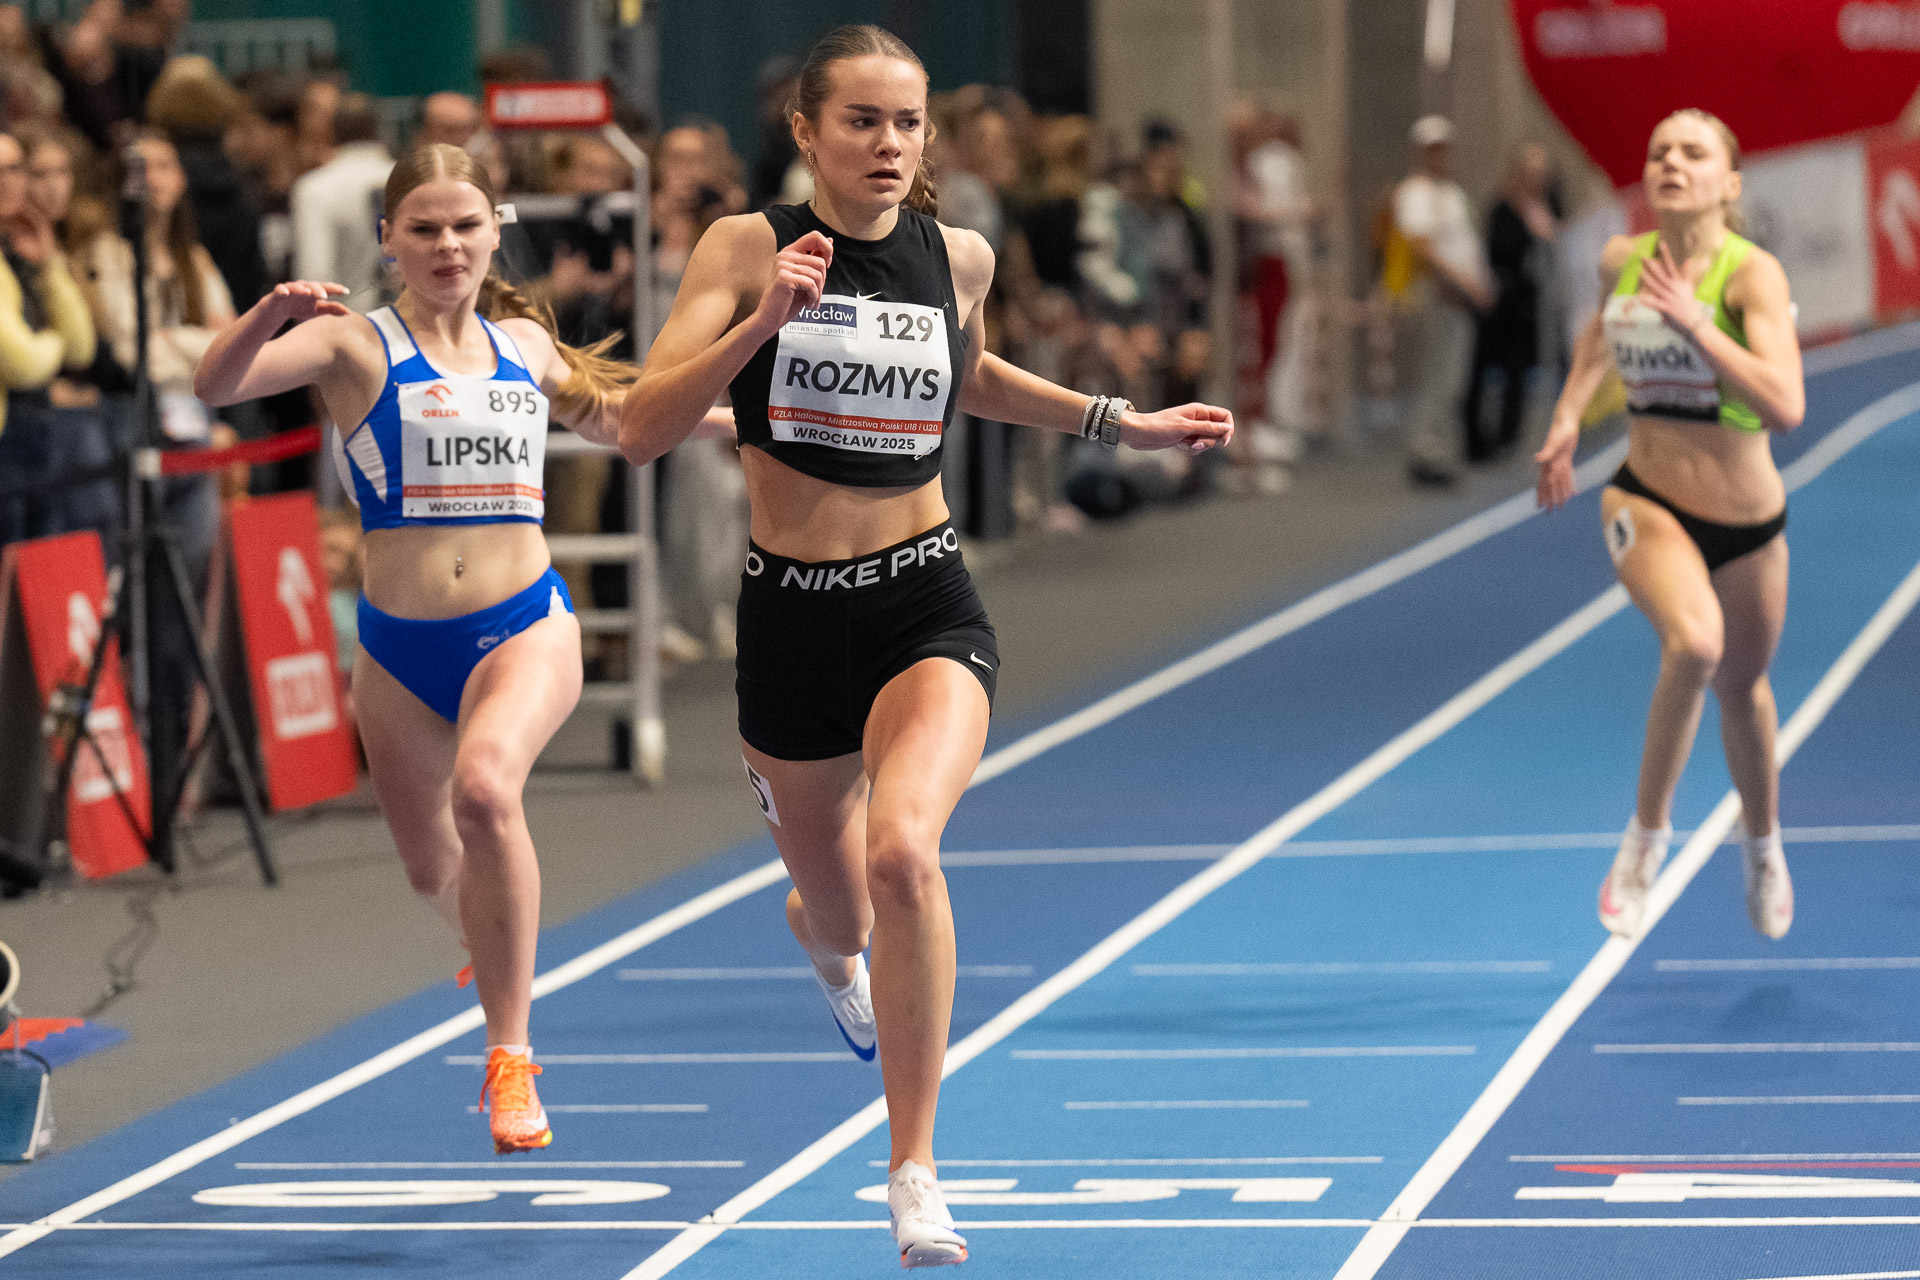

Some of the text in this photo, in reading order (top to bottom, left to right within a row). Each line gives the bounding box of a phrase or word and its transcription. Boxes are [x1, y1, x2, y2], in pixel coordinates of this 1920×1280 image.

[789, 324, 855, 336] miasto spotkań
[876, 312, 933, 342] 129
[785, 357, 940, 402] ROZMYS
[422, 409, 460, 418] ORLEN
[488, 390, 537, 415] 895
[773, 410, 792, 418] PZLA
[794, 411, 826, 422] Halowe
[828, 416, 878, 428] Mistrzostwa
[880, 422, 902, 430] Polski
[903, 423, 917, 431] U18
[922, 424, 938, 432] U20
[793, 426, 916, 450] WROCŁAW 2025
[426, 436, 530, 467] LIPSKA
[428, 501, 504, 513] WROCŁAW
[780, 527, 959, 591] NIKE PRO
[747, 765, 770, 813] 5
